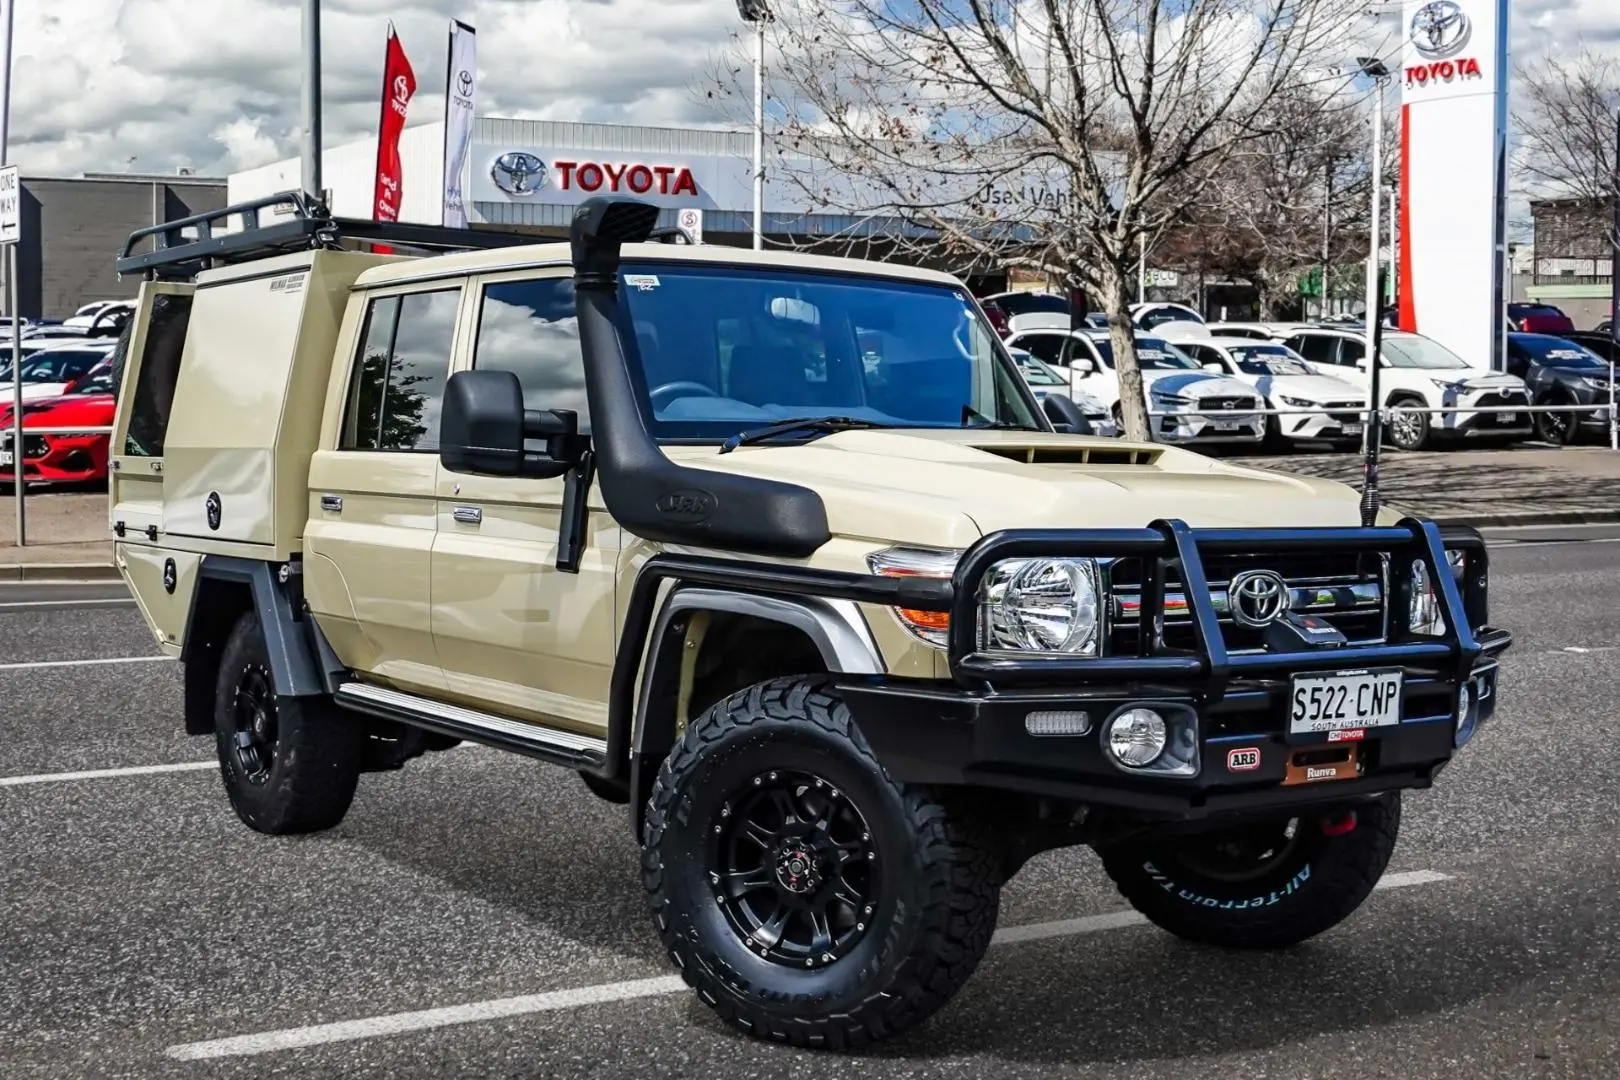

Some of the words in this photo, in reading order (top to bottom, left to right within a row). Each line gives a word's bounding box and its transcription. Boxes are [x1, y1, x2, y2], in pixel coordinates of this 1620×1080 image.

[1404, 58, 1481, 82] TOYOTA
[0, 172, 15, 192] ONE
[554, 161, 698, 196] TOYOTA
[978, 182, 1026, 205] Used
[0, 195, 17, 213] WAY
[1311, 721, 1337, 731] SOUTH
[1340, 718, 1380, 730] AUSTRALIA
[1341, 729, 1365, 740] TOYOTA
[1232, 752, 1256, 767] ARB
[1307, 767, 1337, 778] Runva
[1142, 861, 1175, 893] T/A
[1178, 863, 1312, 909] All-Terrain
